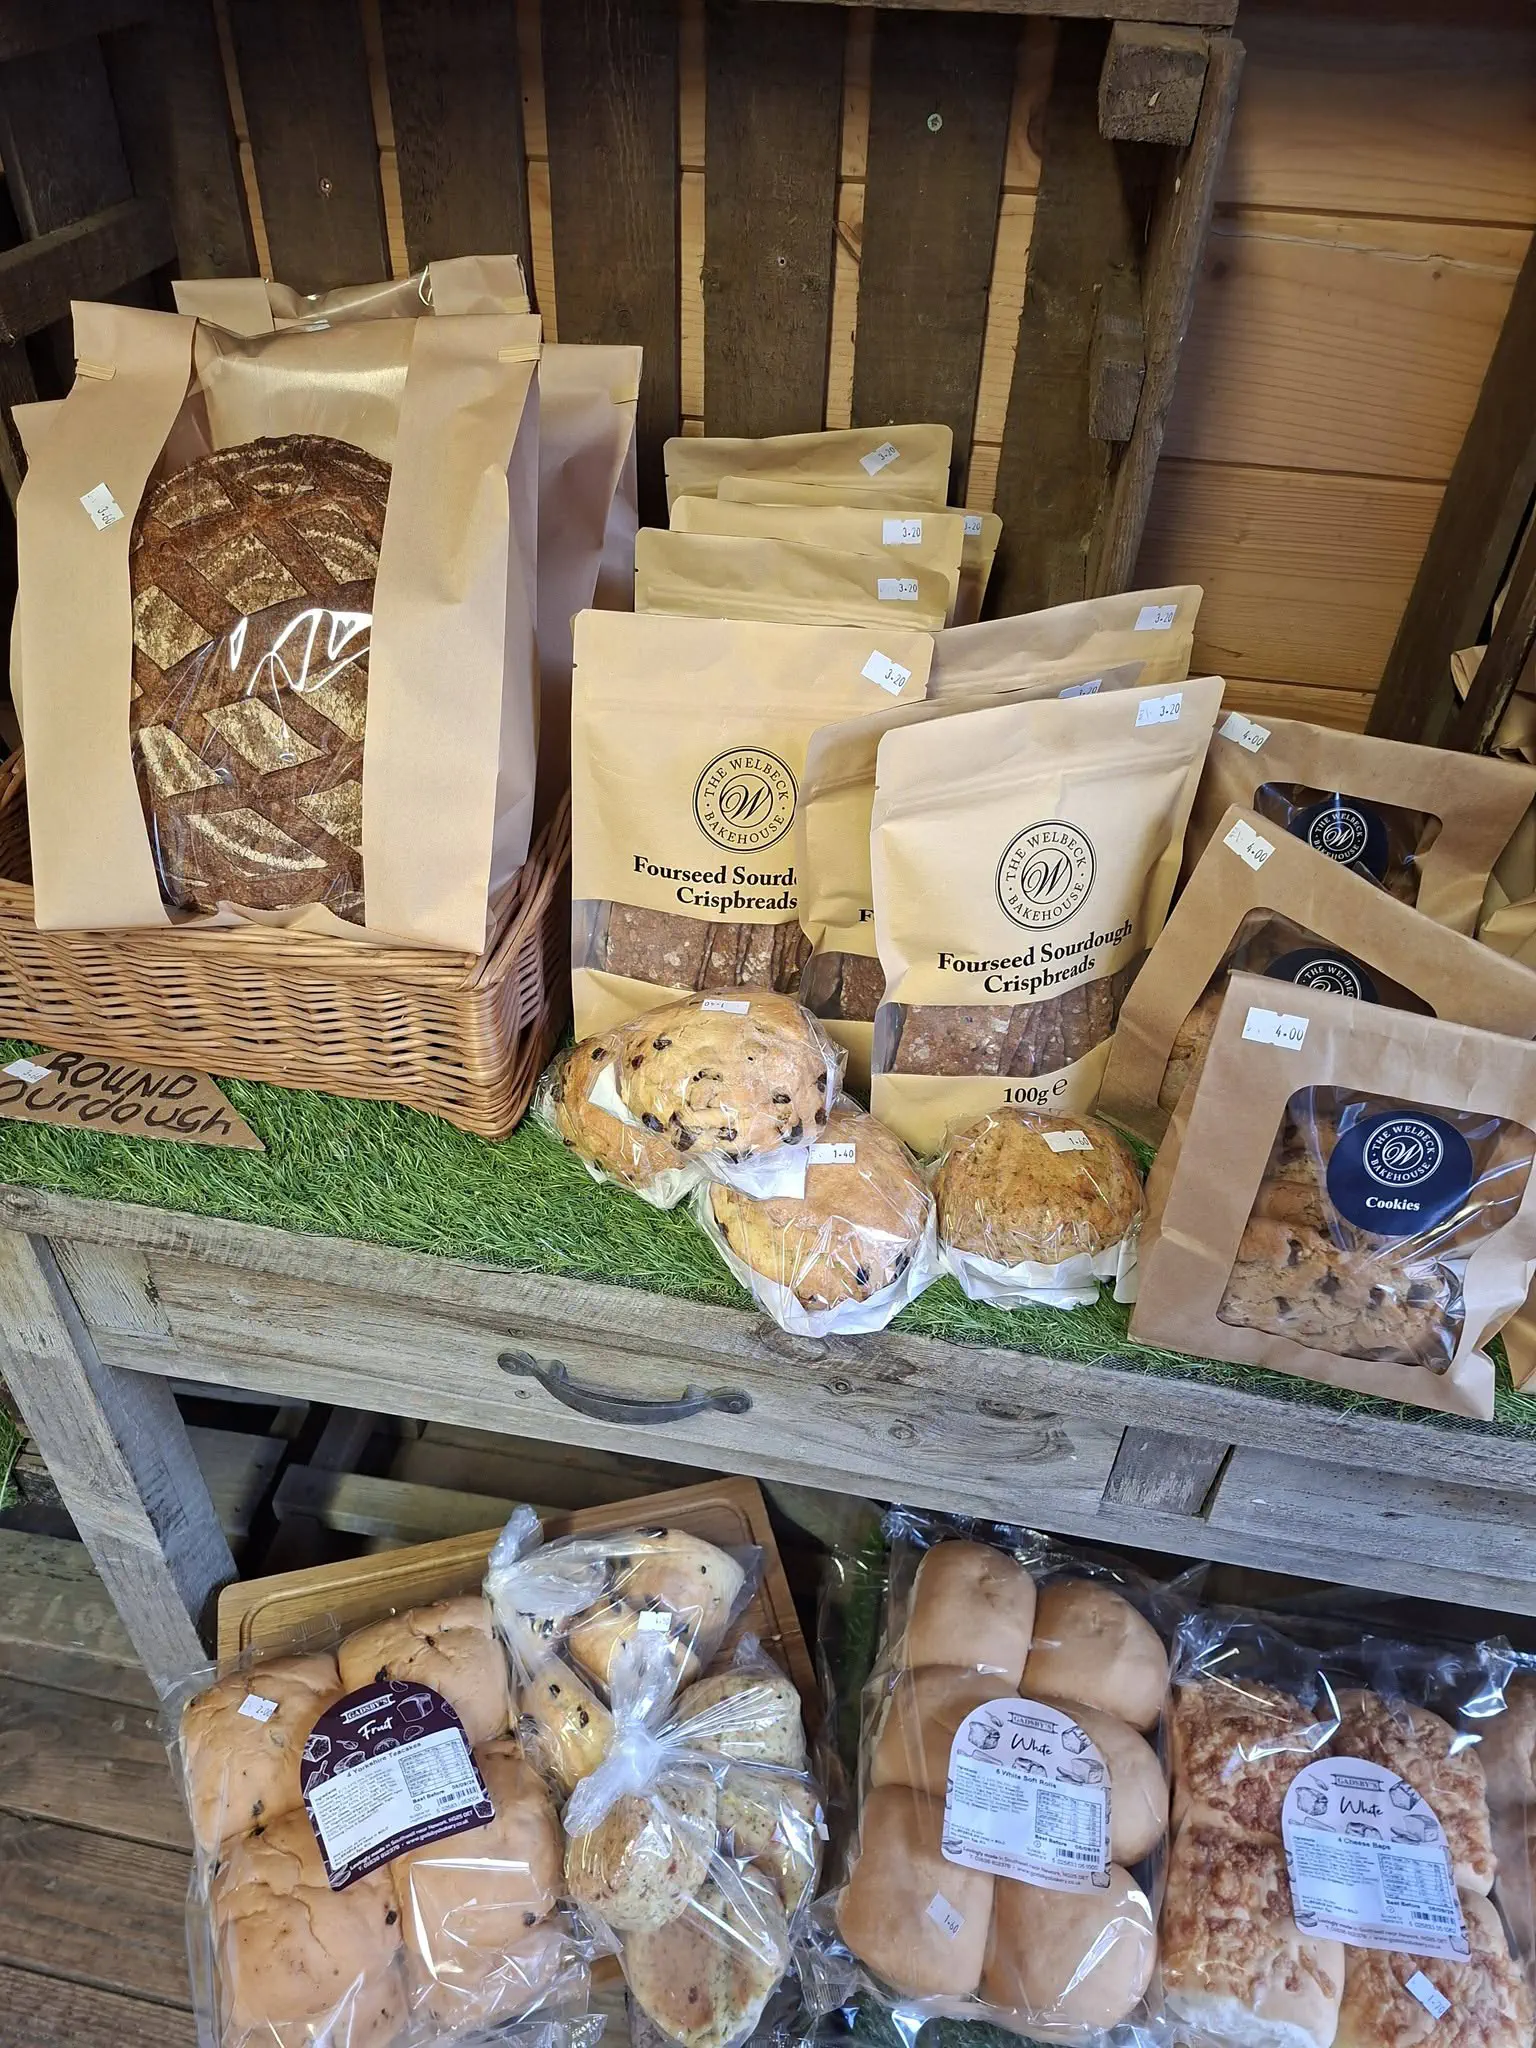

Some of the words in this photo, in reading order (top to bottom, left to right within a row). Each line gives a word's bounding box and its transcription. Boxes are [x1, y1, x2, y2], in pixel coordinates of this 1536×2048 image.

[902, 526, 921, 539] 3.20
[898, 582, 918, 594] 3.20
[1154, 612, 1173, 624] 3.20
[884, 667, 906, 689] 3.20
[1159, 702, 1180, 717] 3.20
[1242, 729, 1264, 747] 4.00
[704, 767, 728, 798] THE
[729, 757, 789, 801] WELBECK
[704, 814, 785, 845] BAKEHOUSE
[1315, 816, 1331, 832] THE
[1006, 848, 1027, 882] THE
[1027, 831, 1087, 868] WELBECK
[1246, 843, 1268, 863] 4.00
[633, 855, 727, 884] Fourseed
[732, 866, 798, 886] Sourd
[676, 886, 798, 914] Crispbreads
[1008, 882, 1084, 921] BAKEHOUSE
[937, 947, 1035, 973] Fourseed
[1040, 919, 1133, 964] Sourdough
[984, 955, 1095, 995] Crispbreads
[1304, 966, 1325, 979] THE
[1328, 965, 1354, 998] WELBEC
[1275, 1025, 1304, 1041] 4.00
[47, 1052, 198, 1100] ROUND
[1003, 1087, 1048, 1106] 100g
[1371, 1130, 1391, 1151] THE
[1392, 1125, 1436, 1154] WELBECK
[1371, 1158, 1431, 1181] BAKEHOUSE
[1365, 1196, 1421, 1211] Cookies
[357, 1716, 393, 1740] Fruit
[1011, 1733, 1053, 1756] White
[352, 1756, 387, 1774] Yorkshire
[1001, 1769, 1021, 1779] White
[1340, 1796, 1384, 1818] White
[944, 1914, 960, 1934] 1.60
